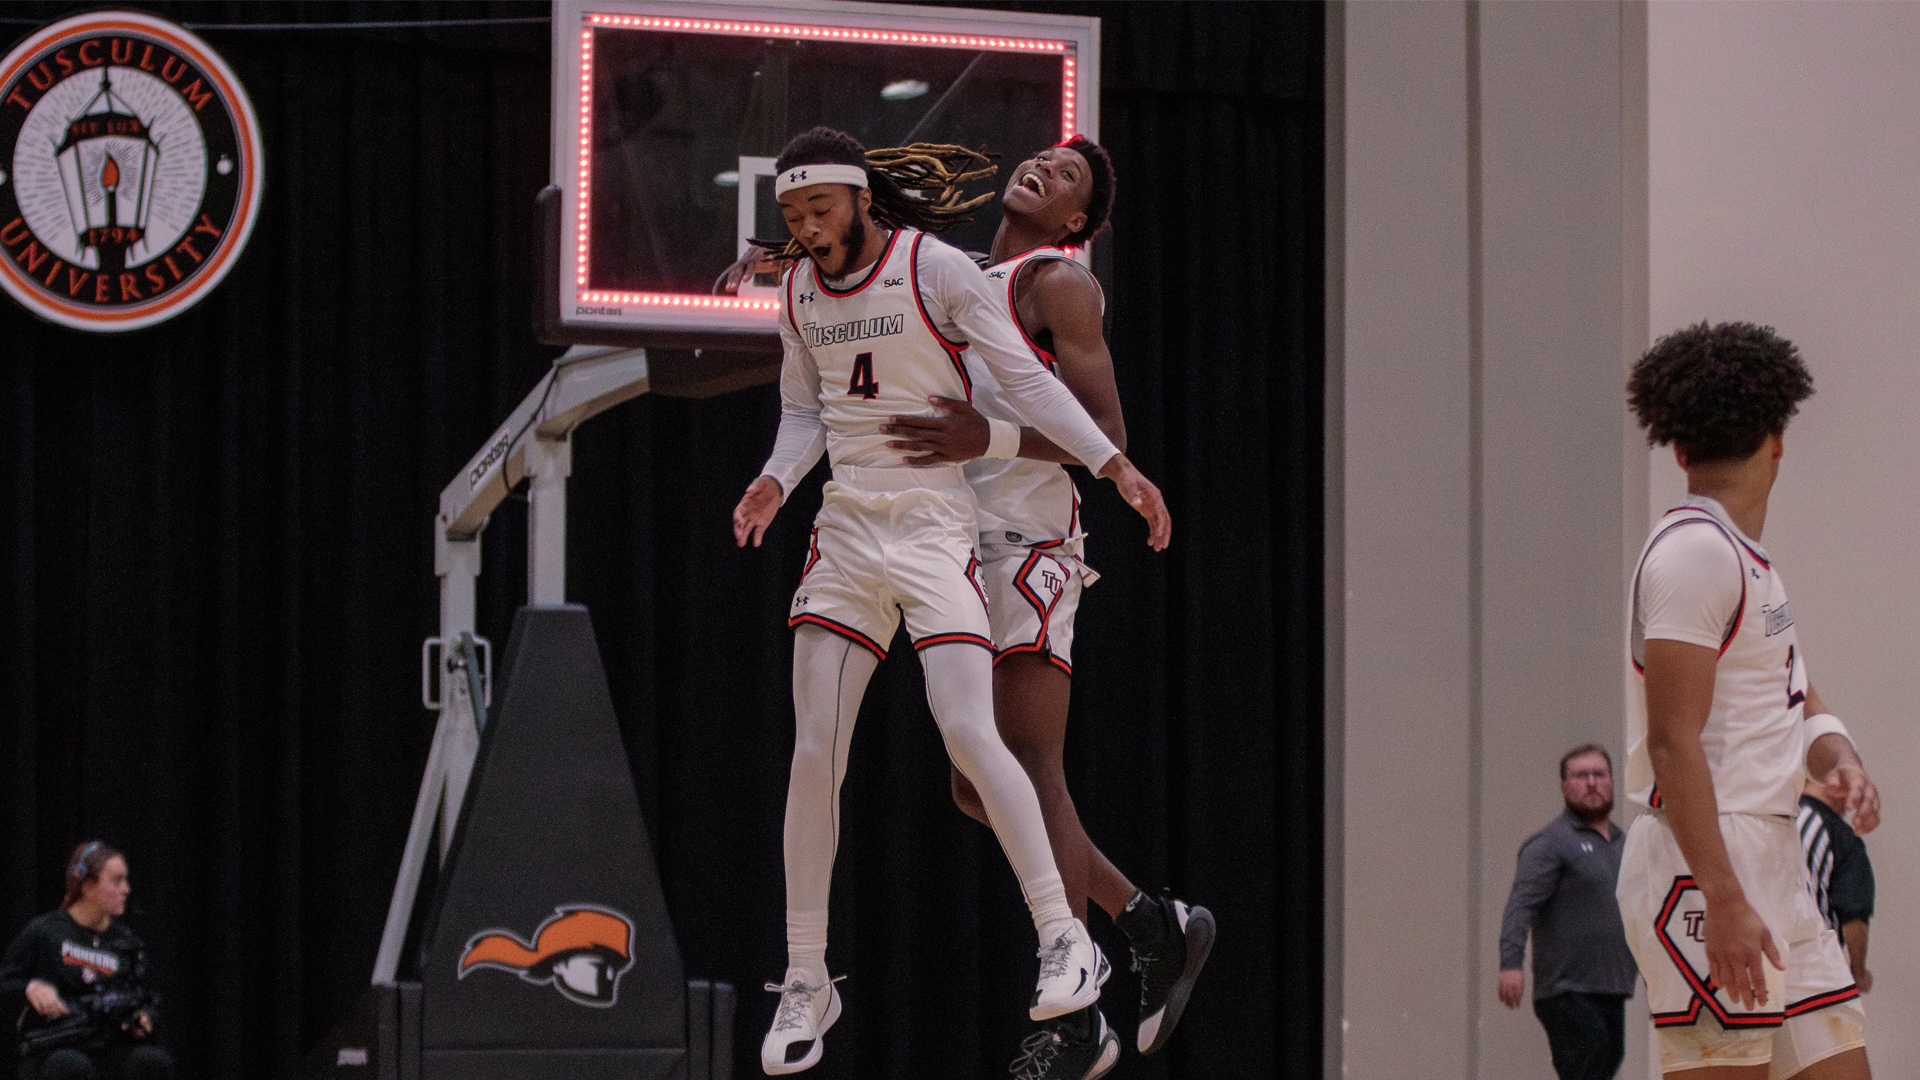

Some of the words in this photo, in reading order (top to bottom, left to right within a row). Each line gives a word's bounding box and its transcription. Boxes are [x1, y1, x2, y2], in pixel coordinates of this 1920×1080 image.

[6, 39, 213, 110] TUSCULUM
[89, 228, 139, 247] 1794
[1, 213, 222, 302] UNIVERSITY
[884, 277, 904, 288] SAC
[989, 271, 1006, 279] SAC
[802, 313, 904, 348] TUSCULUM
[847, 351, 880, 401] 4
[1042, 570, 1063, 597] TU
